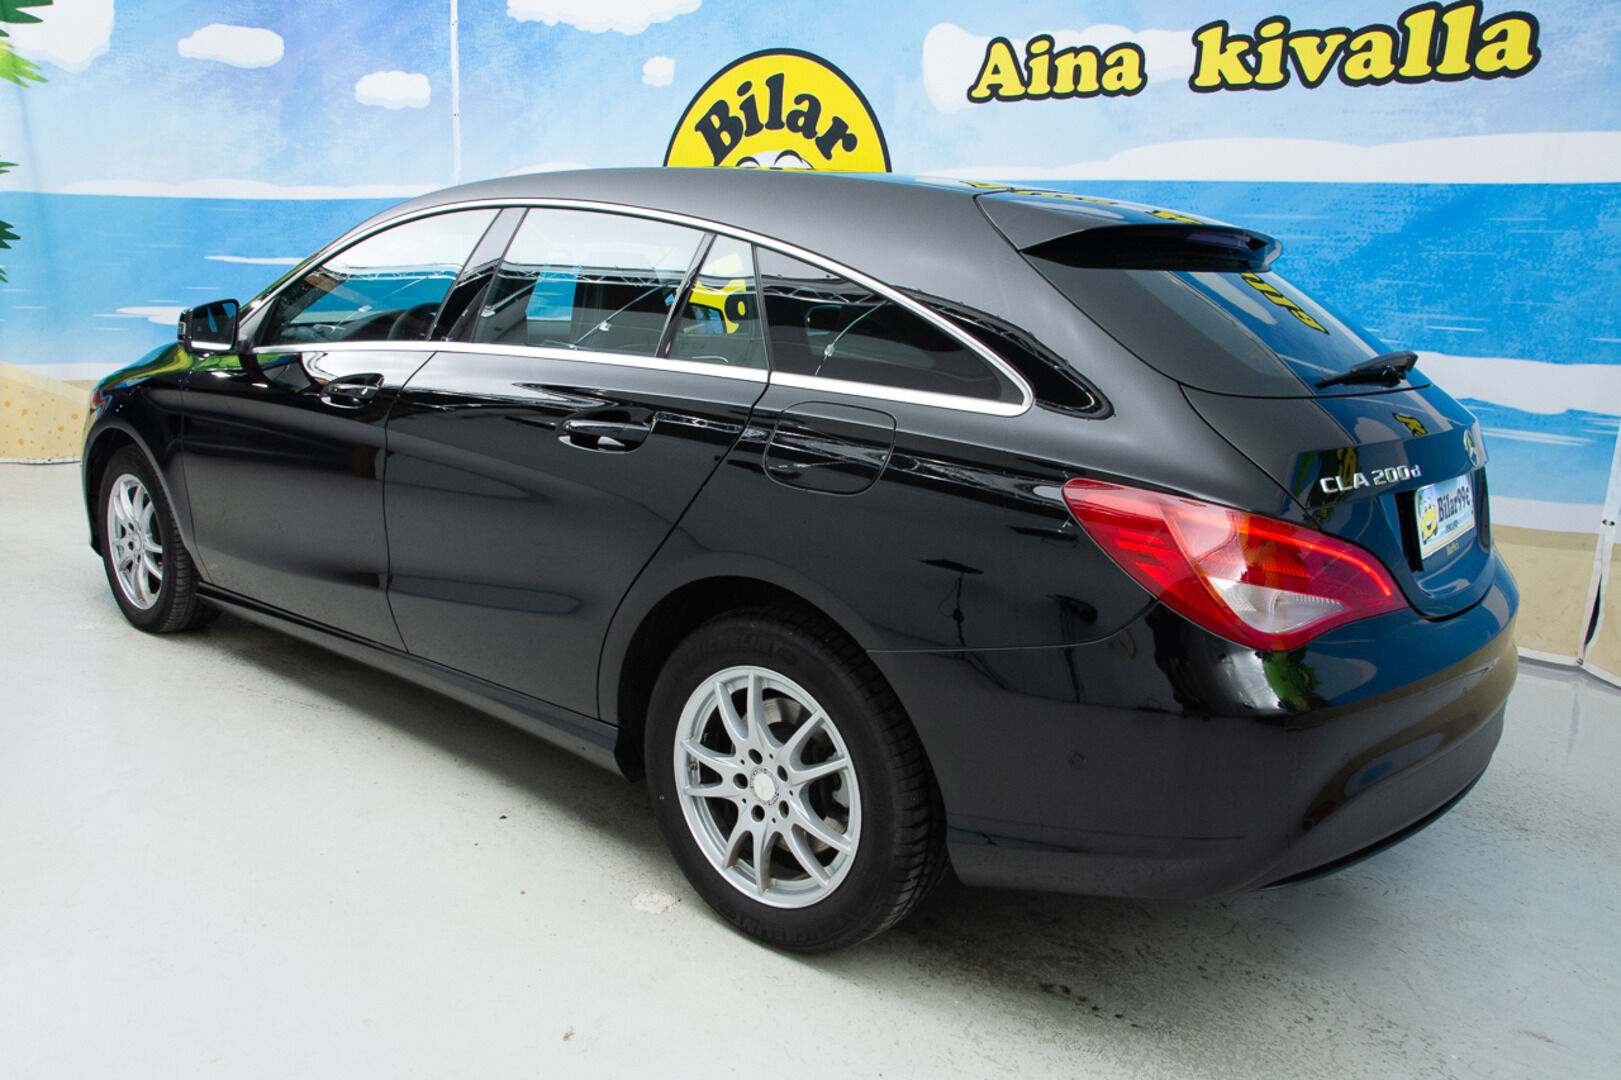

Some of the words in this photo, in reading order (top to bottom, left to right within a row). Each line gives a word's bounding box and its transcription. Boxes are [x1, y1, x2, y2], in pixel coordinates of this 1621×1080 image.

[968, 35, 1147, 102] Aina
[1190, 1, 1541, 92] kivalla
[694, 73, 858, 166] Bilar
[1320, 473, 1370, 494] CLA
